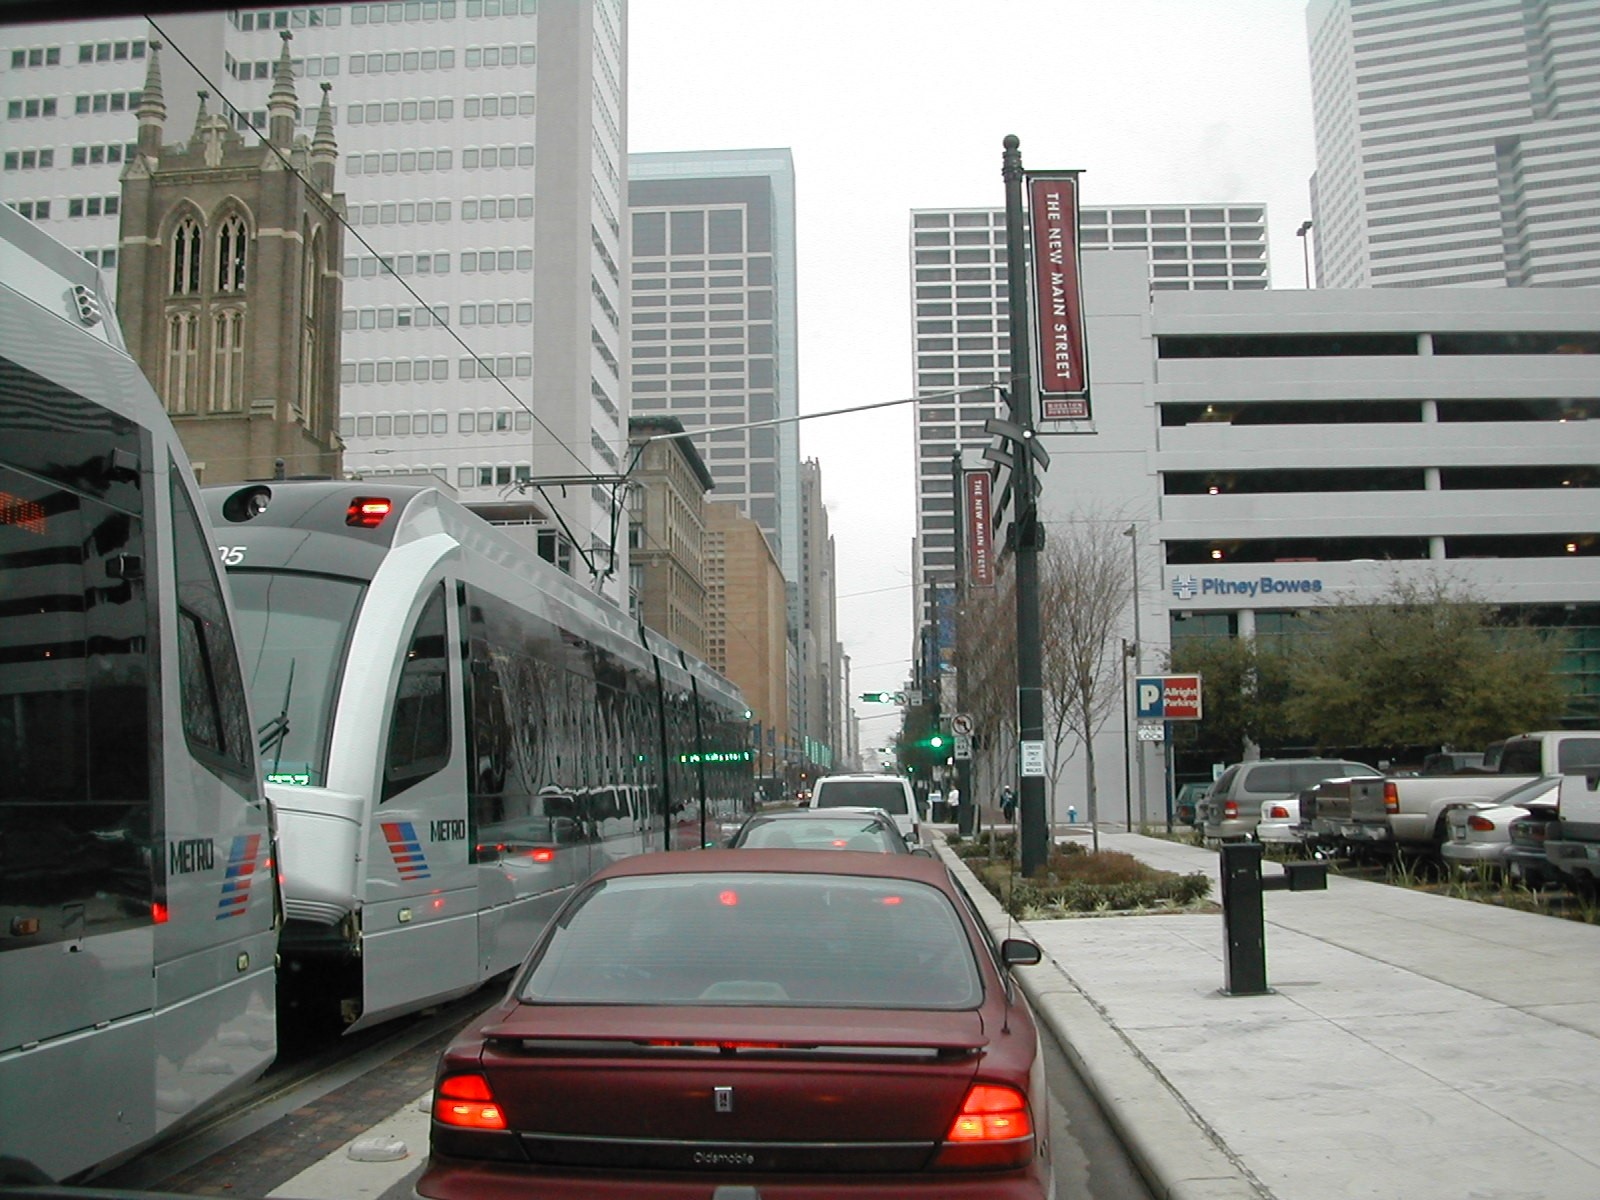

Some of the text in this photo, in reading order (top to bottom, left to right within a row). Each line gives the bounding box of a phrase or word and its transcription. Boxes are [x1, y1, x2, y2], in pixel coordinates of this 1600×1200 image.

[1046, 192, 1070, 379] THE NEW MAIN STREET
[974, 480, 983, 496] THE
[975, 499, 984, 520] NEW
[976, 522, 985, 547] MAIN
[1141, 684, 1160, 710] P
[1163, 688, 1198, 698] Allright
[1163, 698, 1200, 709] Parking
[430, 819, 466, 842] METRO
[170, 838, 214, 875] METRO
